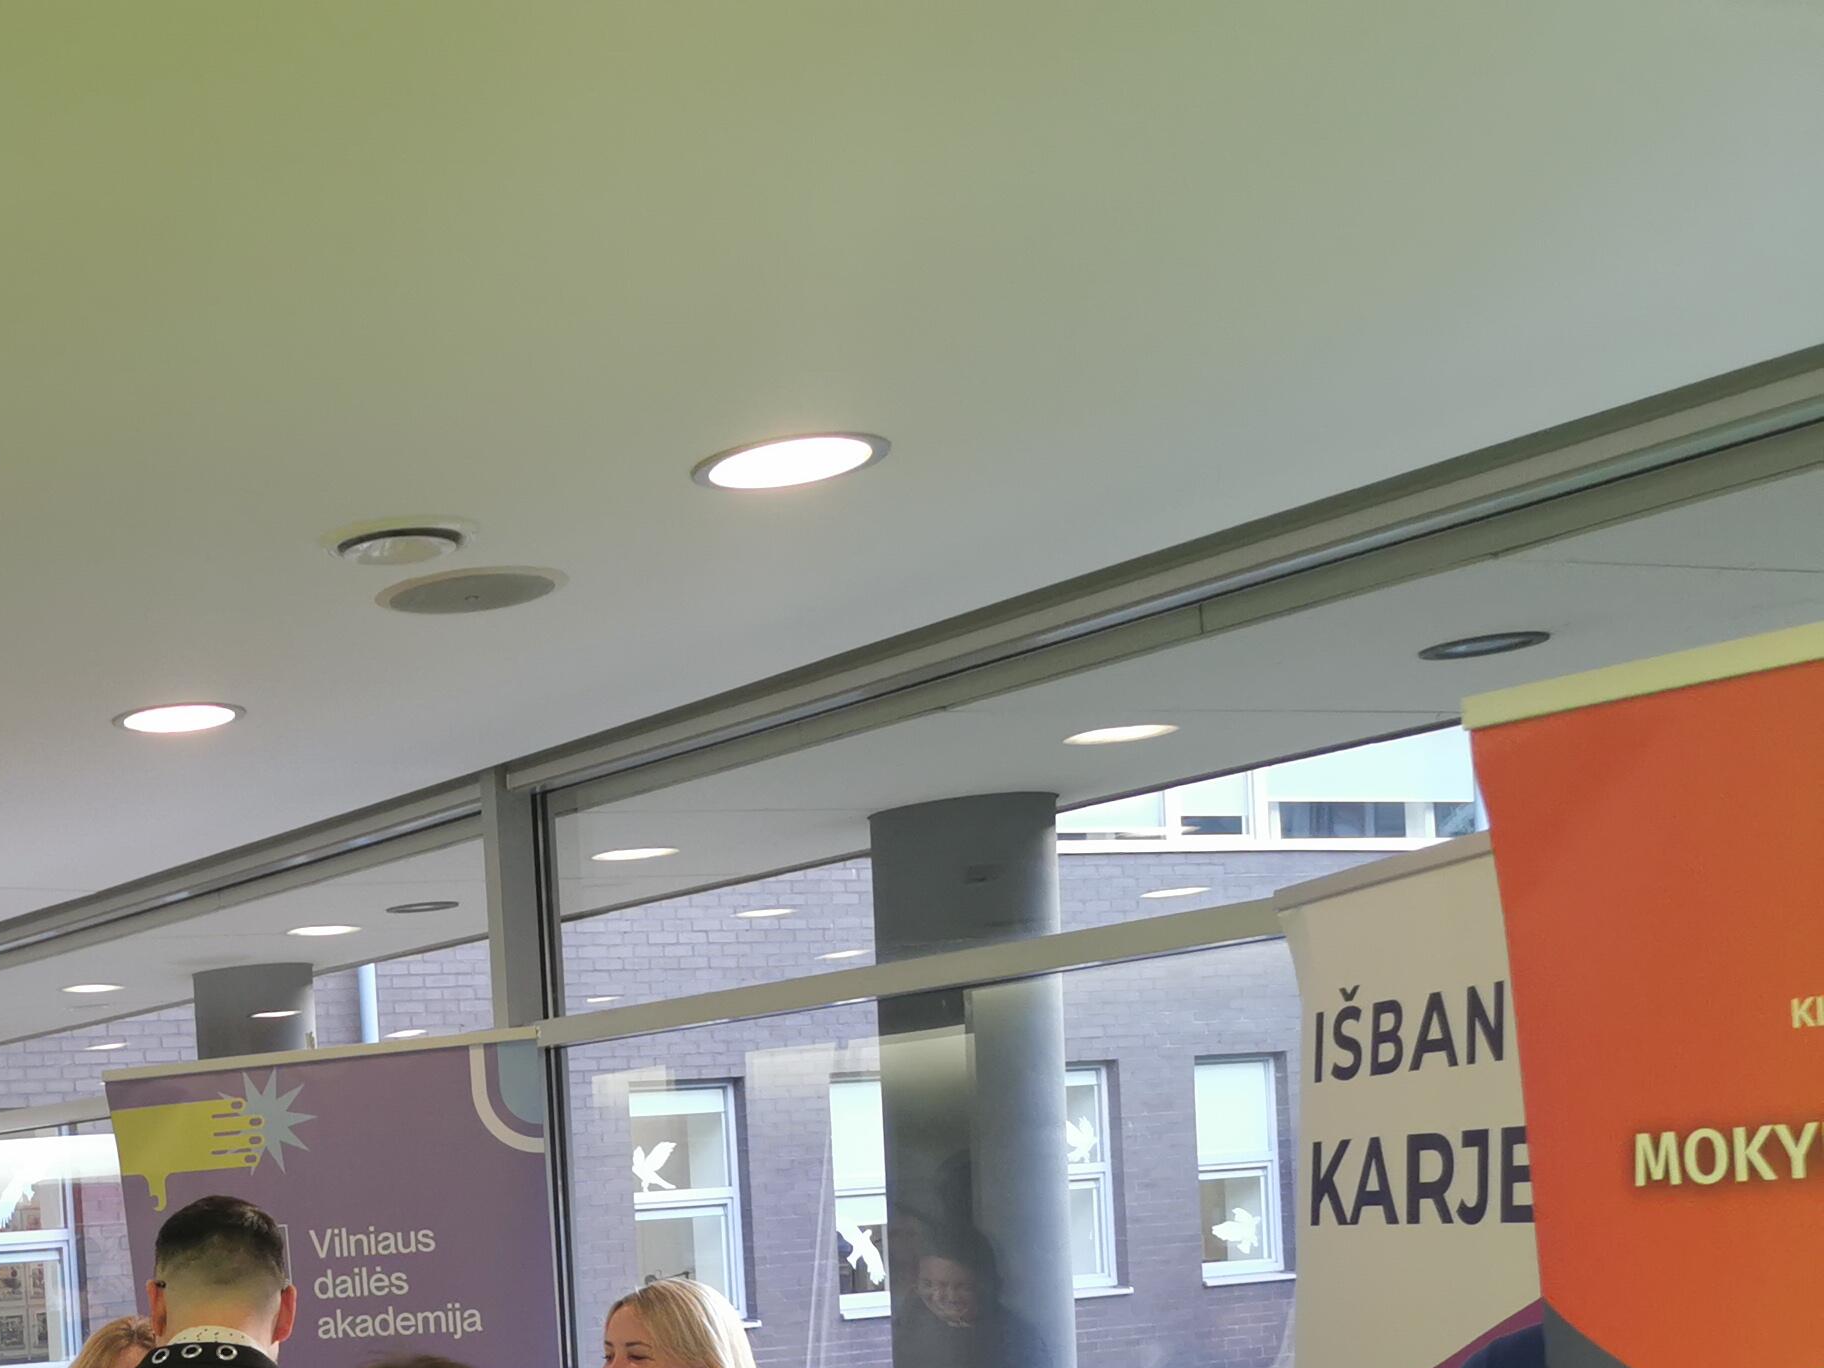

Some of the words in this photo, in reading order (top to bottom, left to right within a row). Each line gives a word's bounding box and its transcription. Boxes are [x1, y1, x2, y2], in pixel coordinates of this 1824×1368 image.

[1634, 1121, 1824, 1188] MOKY
[308, 1225, 437, 1260] Vilniaus
[314, 1266, 409, 1300] dailės
[317, 1302, 483, 1340] akademija
